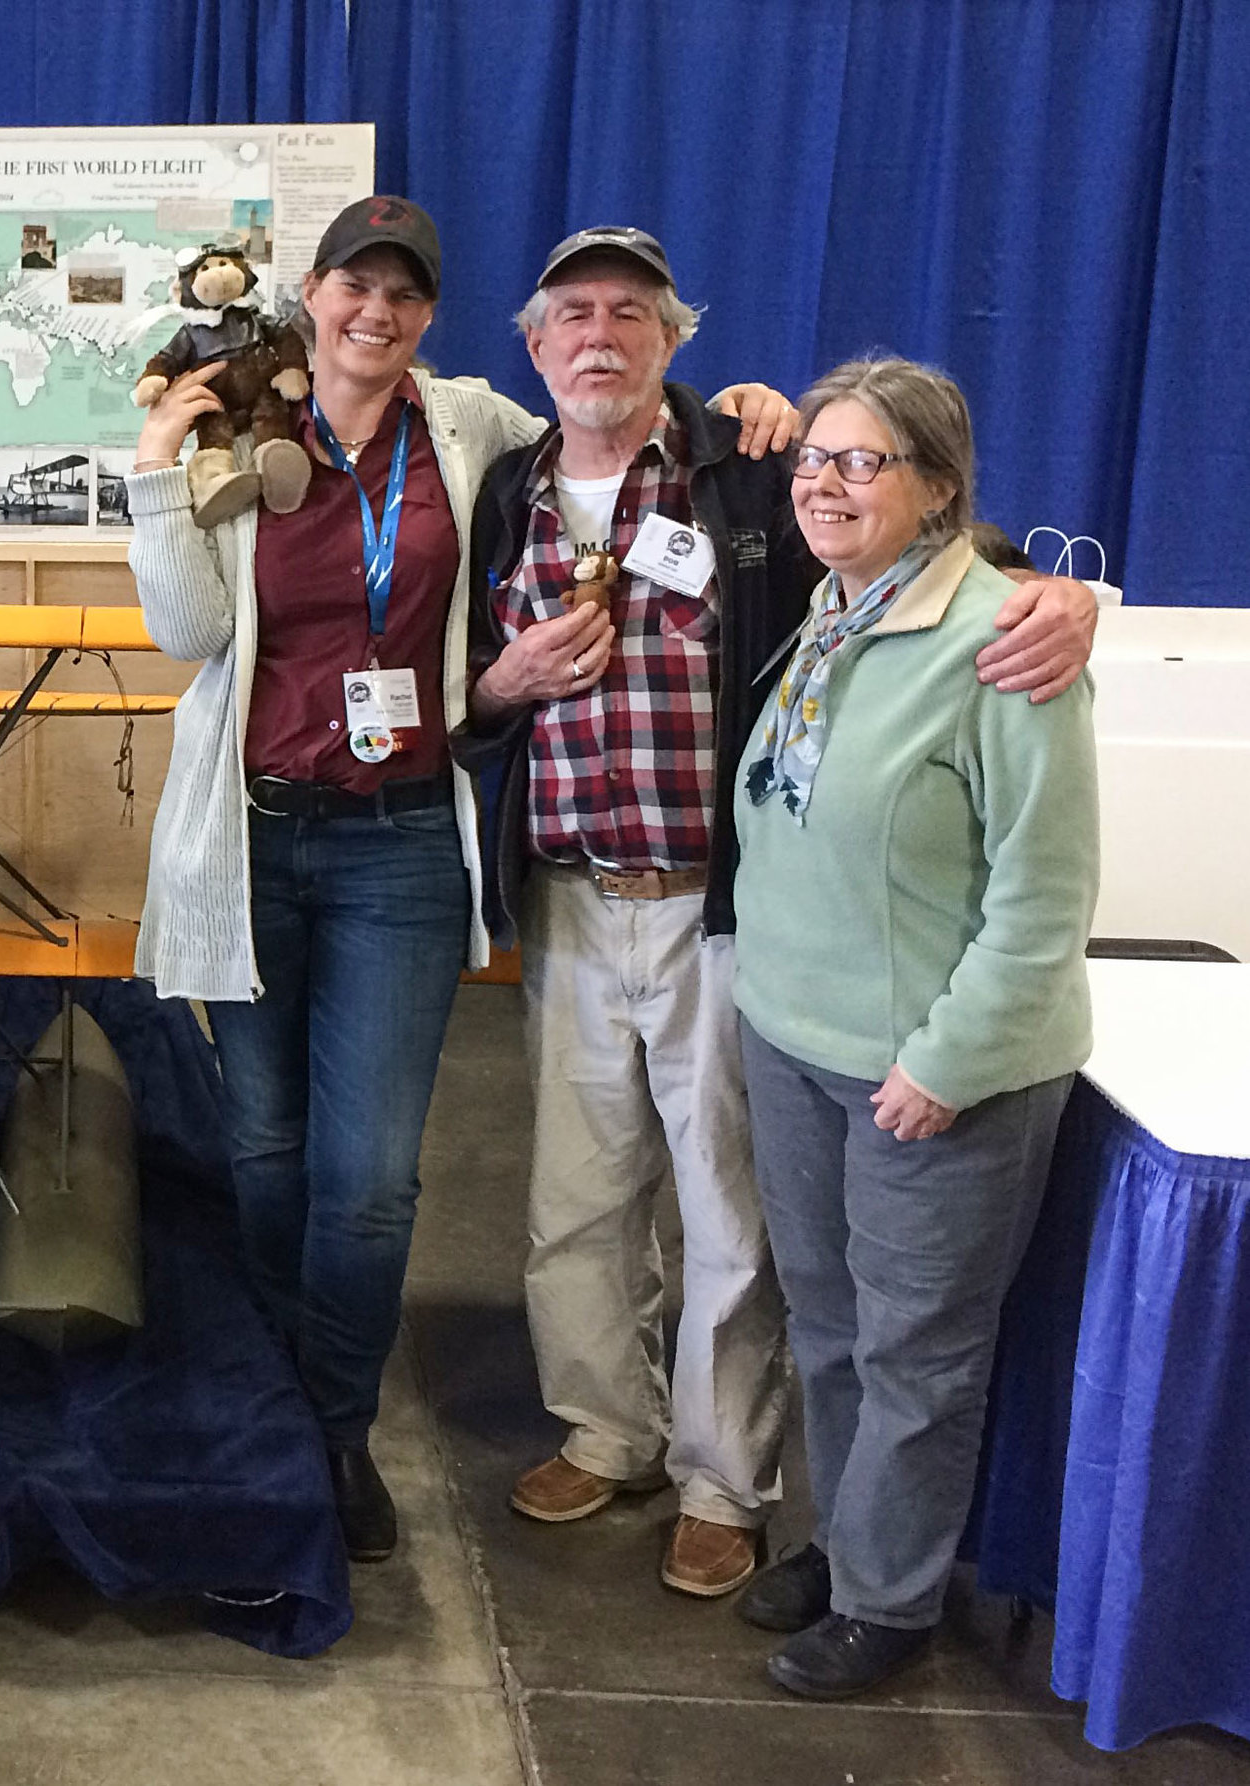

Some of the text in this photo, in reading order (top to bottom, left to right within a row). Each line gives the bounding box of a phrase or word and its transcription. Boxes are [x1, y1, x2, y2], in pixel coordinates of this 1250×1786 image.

[26, 160, 68, 175] FIRST
[74, 160, 136, 175] WORLD
[142, 160, 206, 175] FLIGHT
